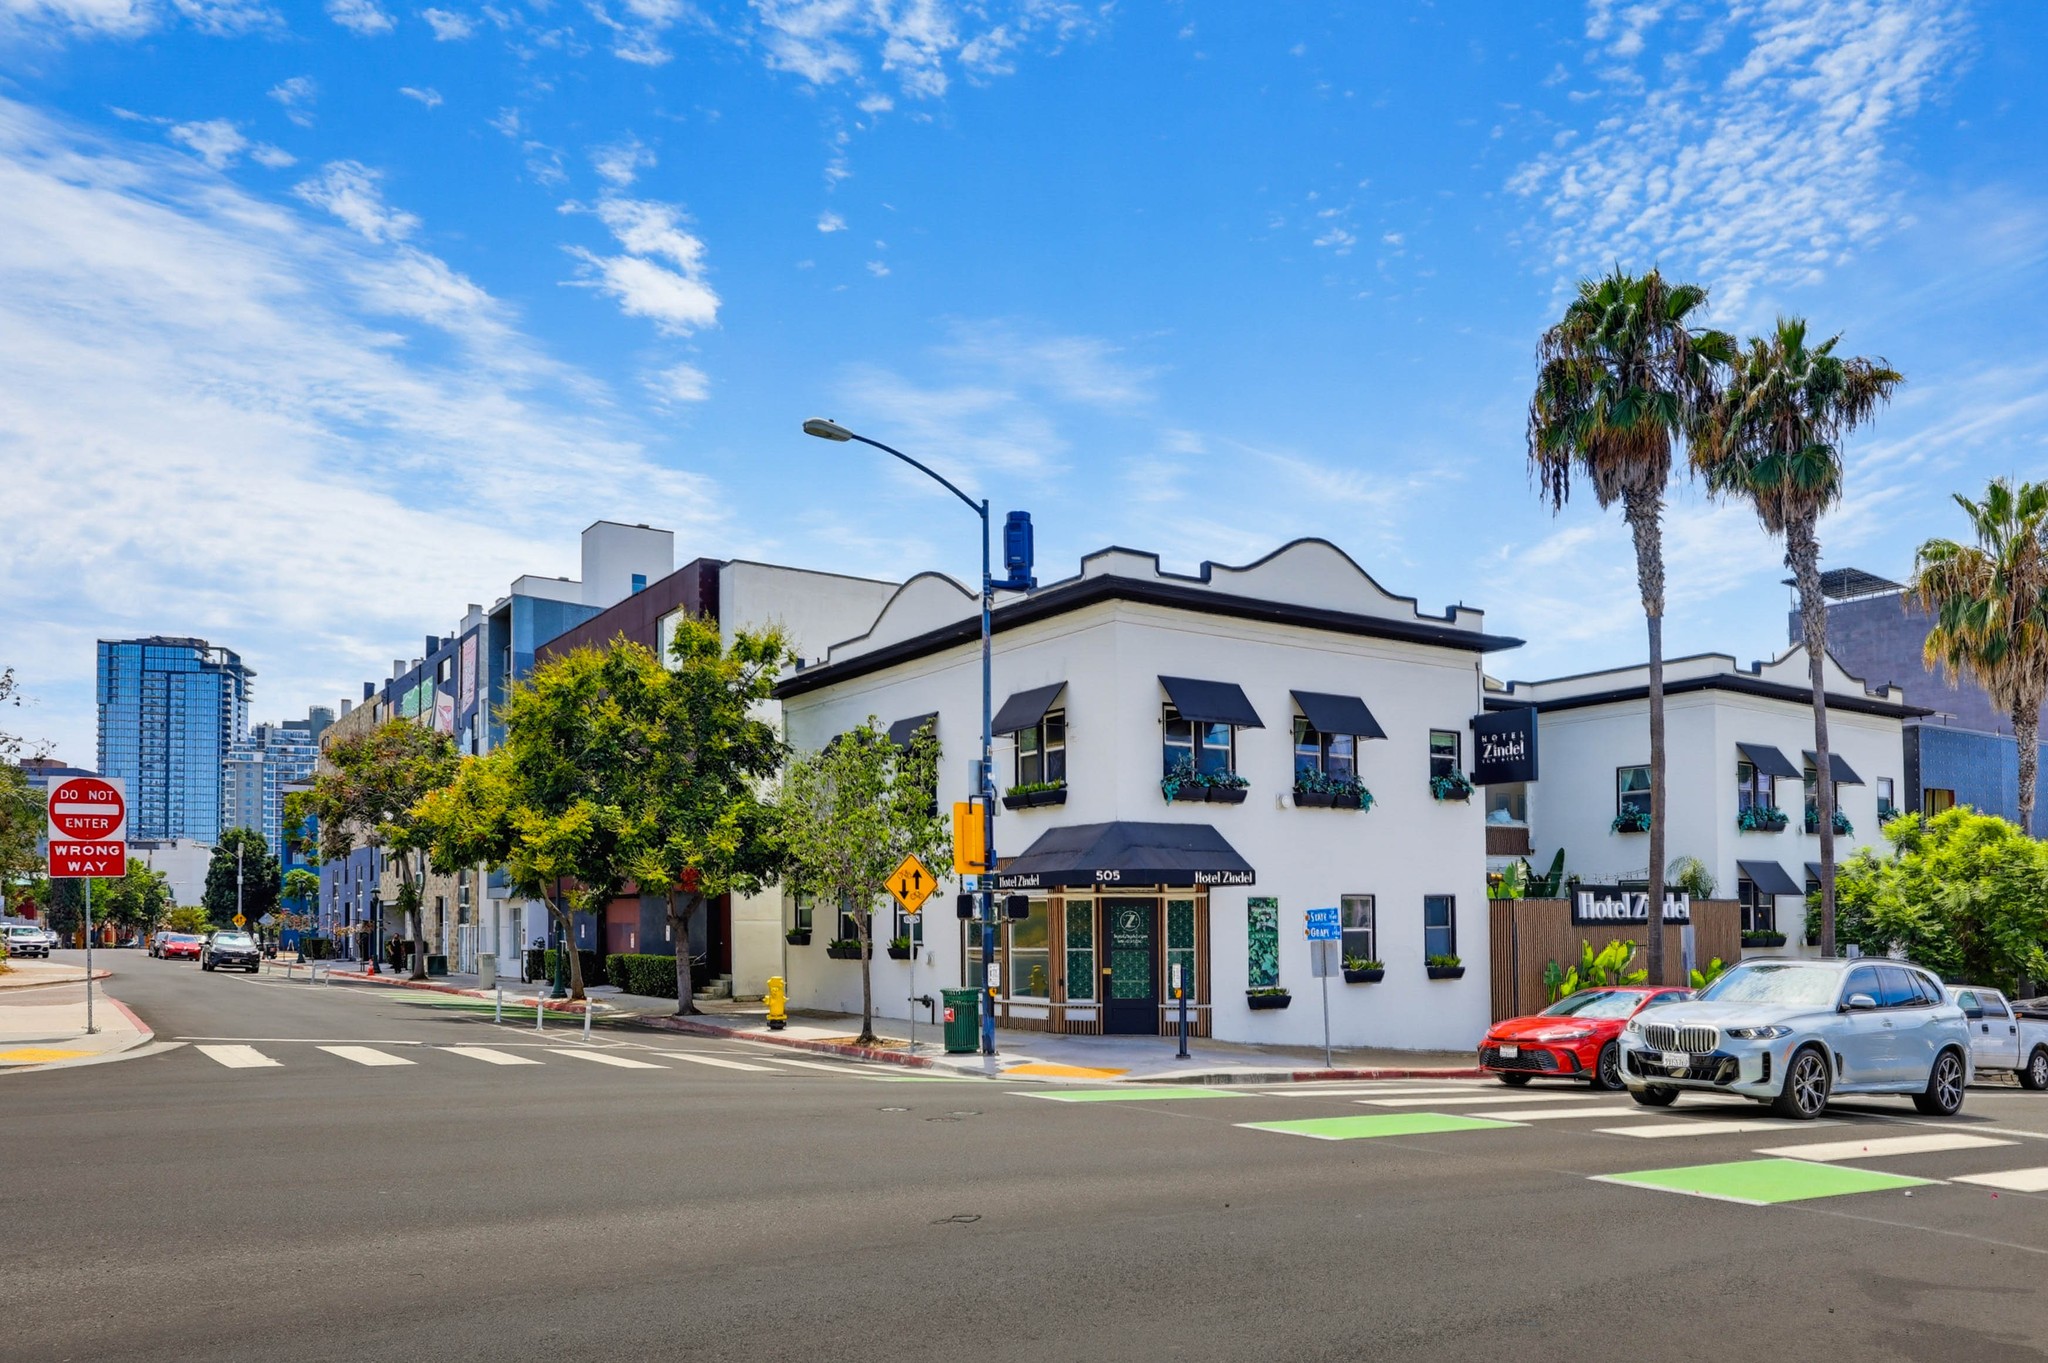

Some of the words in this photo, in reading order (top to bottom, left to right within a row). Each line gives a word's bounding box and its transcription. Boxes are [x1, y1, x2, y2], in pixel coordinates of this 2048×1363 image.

[1481, 731, 1524, 742] HOTEL
[1483, 740, 1524, 758] Zindel
[60, 789, 78, 800] DO
[88, 790, 114, 800] NOT
[65, 818, 108, 828] ENTER
[54, 845, 120, 856] WRONG
[67, 861, 108, 871] WAY
[1096, 869, 1120, 881] 505
[1195, 870, 1220, 883] Hotel
[1222, 870, 1253, 883] Zindel
[999, 876, 1017, 888] Hotel
[1578, 891, 1631, 919] Hotel
